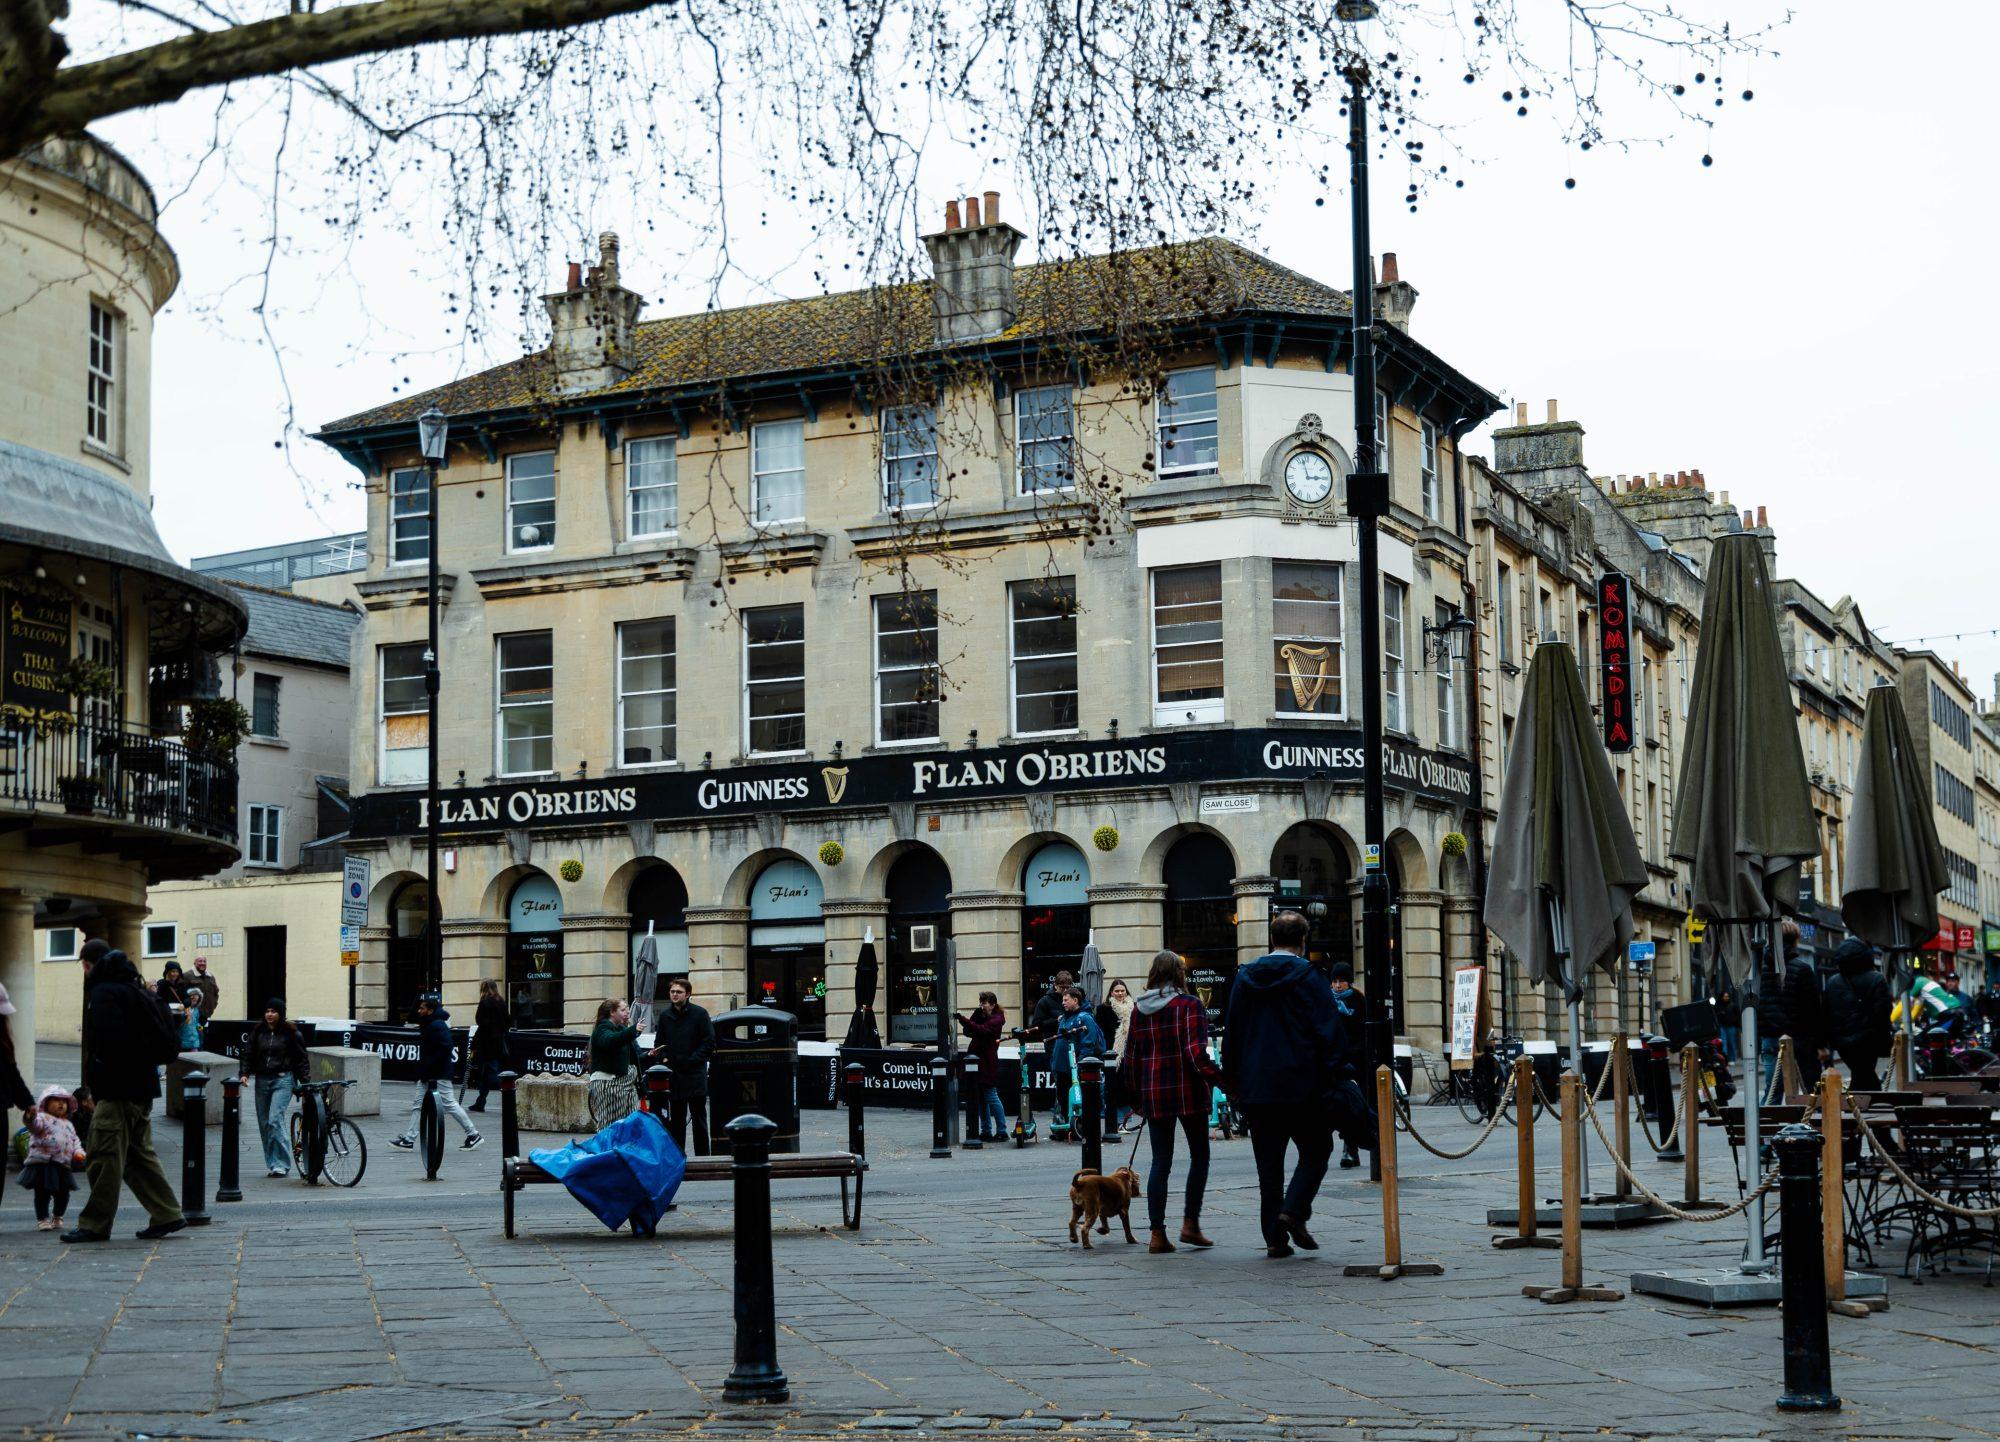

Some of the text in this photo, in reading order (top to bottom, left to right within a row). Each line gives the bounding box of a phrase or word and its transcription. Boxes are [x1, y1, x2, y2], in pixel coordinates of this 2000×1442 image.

[1603, 583, 1628, 742] KOMEDIA
[13, 670, 64, 693] CUISIN
[1263, 740, 1365, 770] GUINNESS
[912, 747, 1166, 794] FLAN O'BRIENS
[1382, 742, 1471, 796] FLAN O'BRIENS
[697, 777, 809, 810] GUINNESS
[508, 787, 637, 822] O'BRIENS
[1205, 799, 1250, 808] SAW CLOSE
[348, 872, 365, 880] ZONE
[1038, 869, 1080, 888] Flan's
[769, 885, 808, 902] Flan's
[520, 900, 557, 916] Flan's
[544, 1046, 574, 1058] Come
[527, 1059, 584, 1076] It's a Lovely
[882, 1062, 931, 1075] Come in.
[828, 1057, 836, 1101] GUINNESS
[864, 1076, 881, 1088] It's
[882, 1080, 890, 1088] a
[892, 1077, 928, 1092] Lovely
